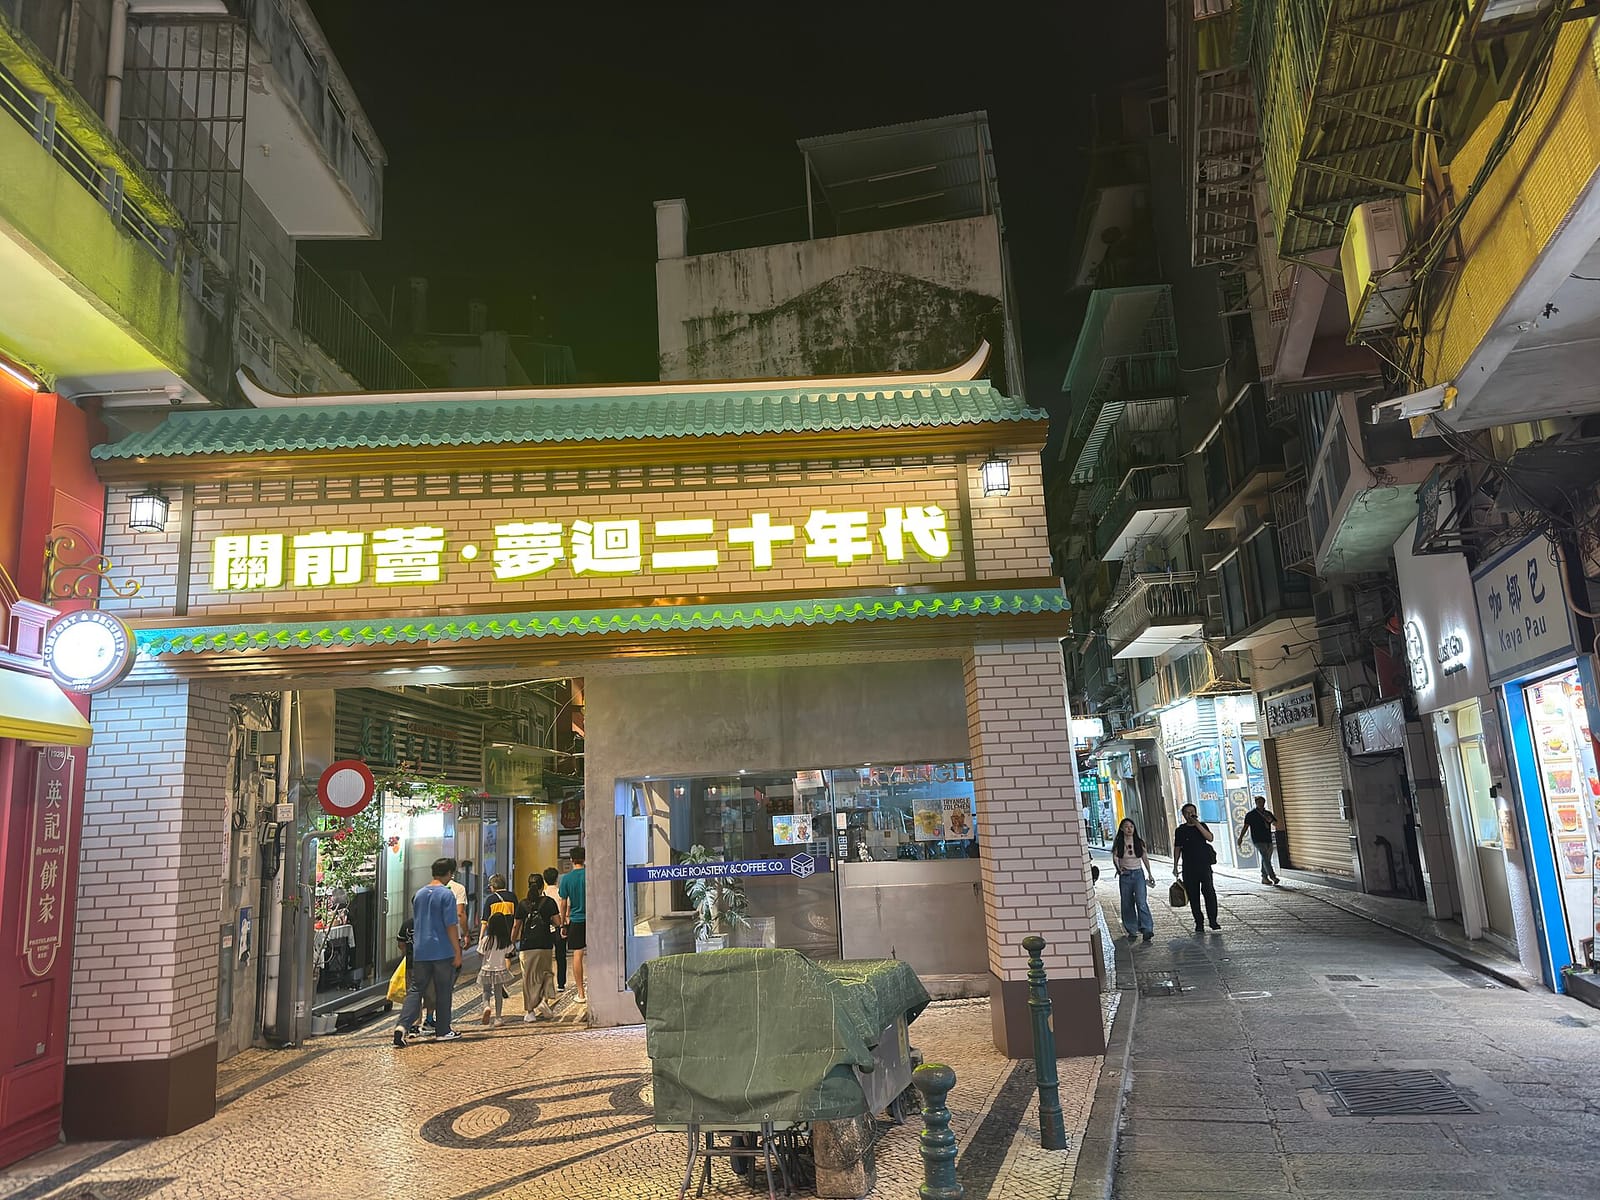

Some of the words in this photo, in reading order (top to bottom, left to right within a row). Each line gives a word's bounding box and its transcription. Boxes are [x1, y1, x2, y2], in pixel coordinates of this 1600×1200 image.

[1488, 558, 1546, 625] 咖椰包
[92, 613, 125, 658] SECURITY
[1498, 627, 1523, 652] Kaya
[1525, 615, 1547, 640] Pau
[647, 869, 688, 880] TRYANGLE
[688, 866, 728, 877] ROASTERY
[768, 861, 785, 872] CO.
